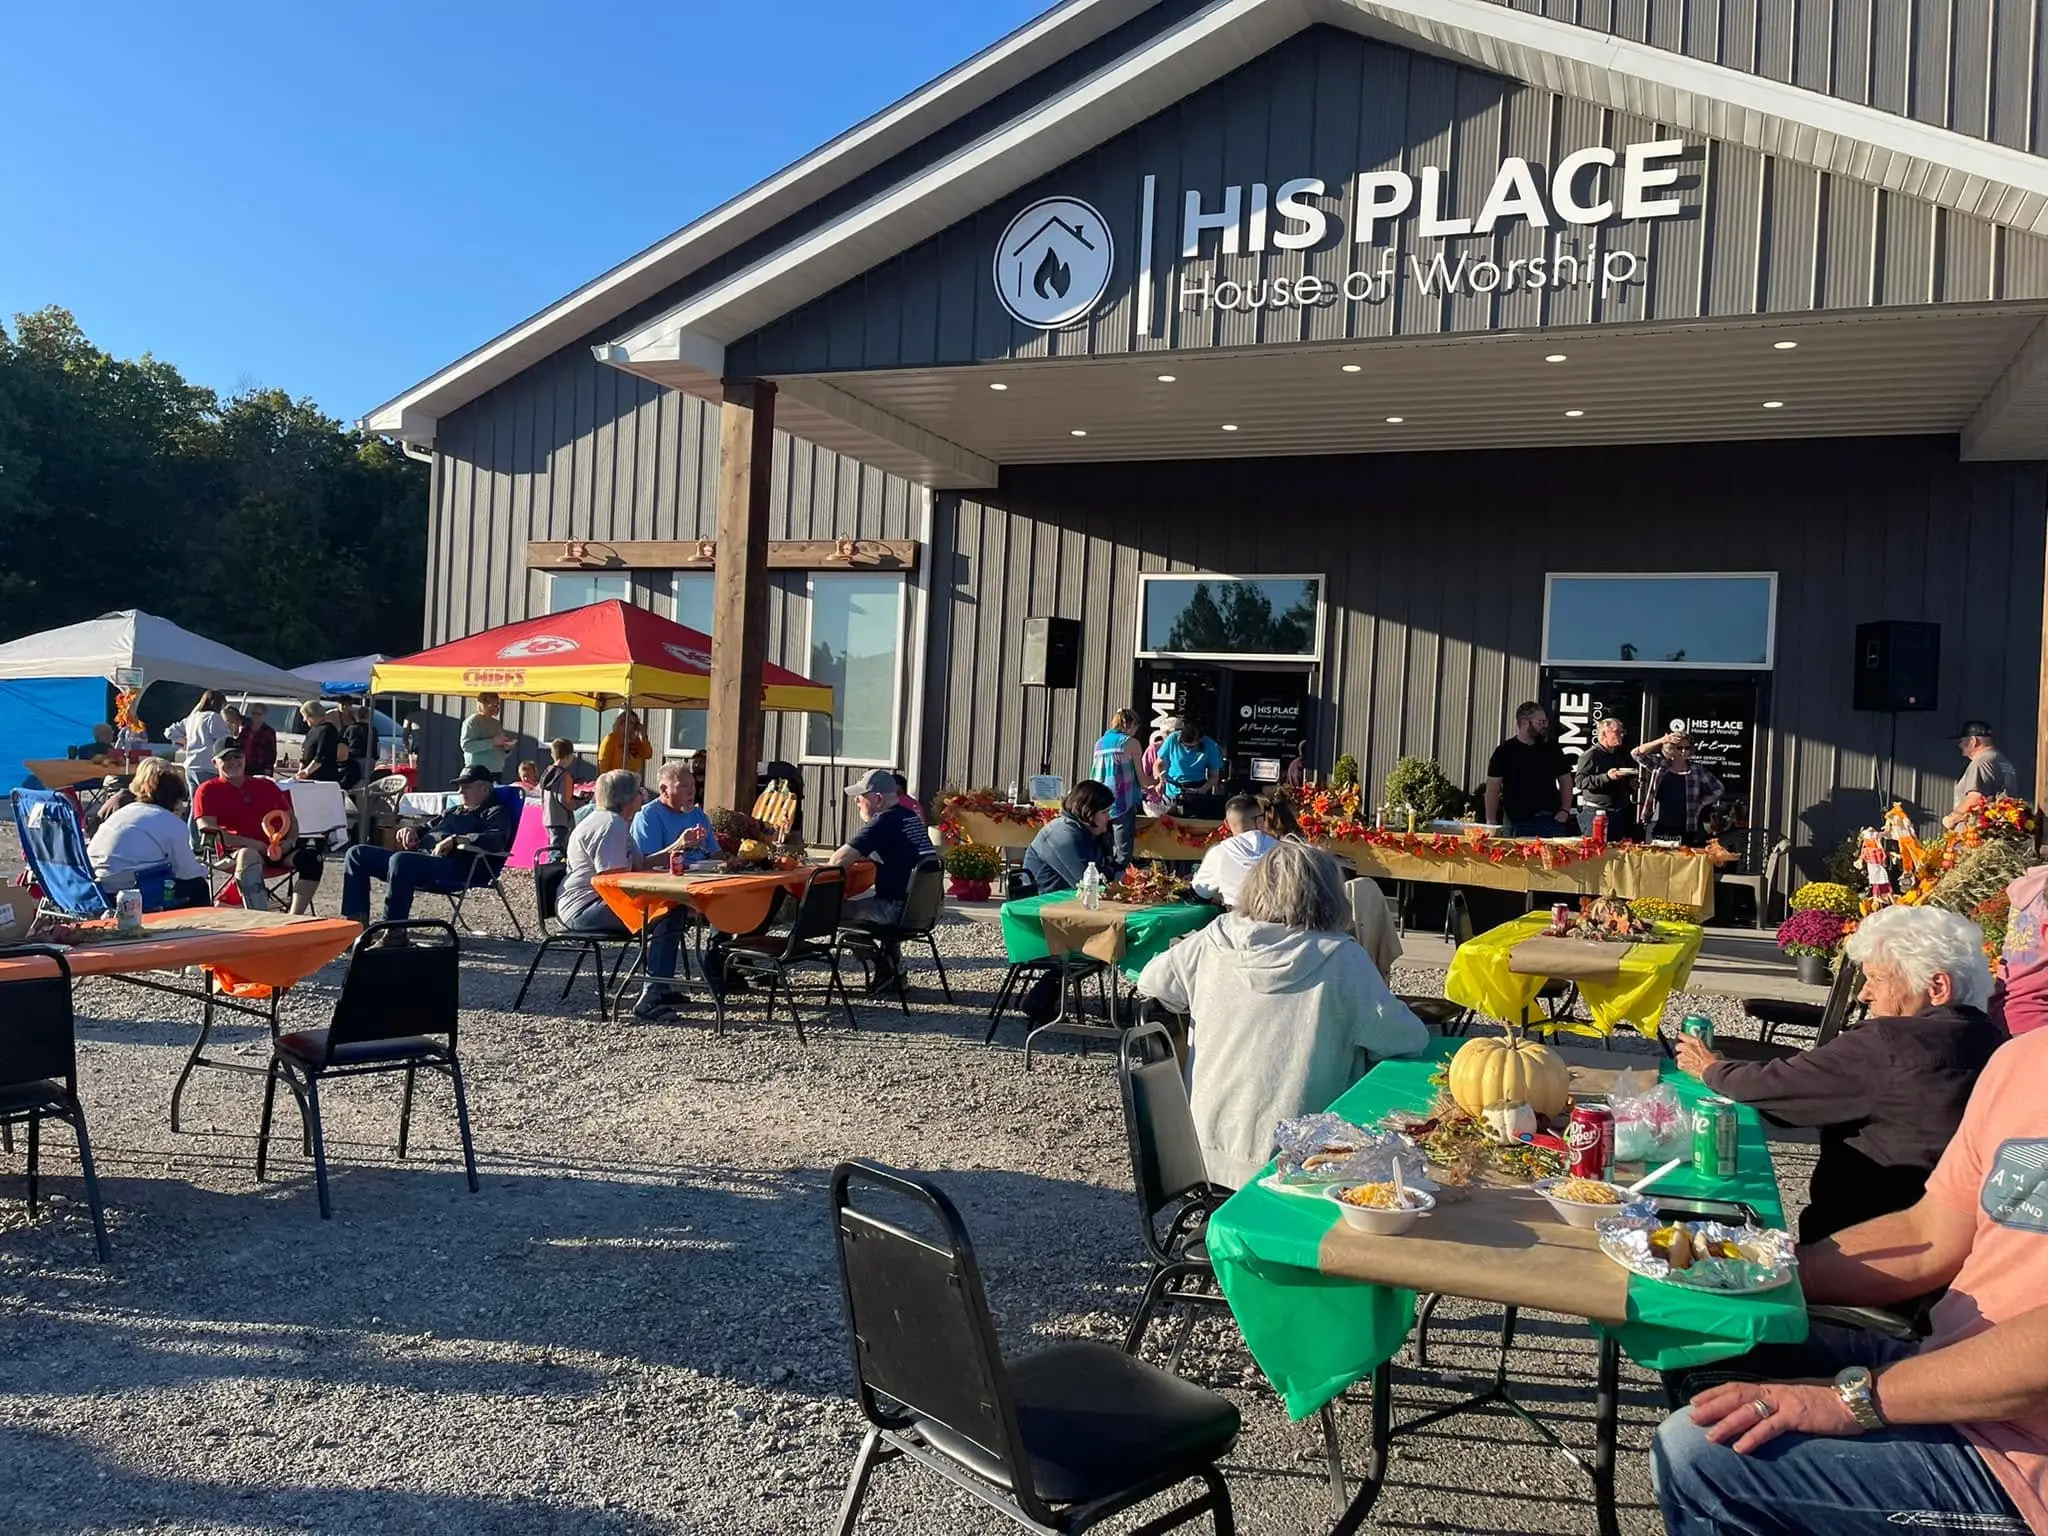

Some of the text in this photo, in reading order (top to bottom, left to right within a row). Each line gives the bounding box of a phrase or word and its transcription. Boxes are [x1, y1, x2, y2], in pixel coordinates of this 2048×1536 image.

[1183, 139, 1683, 257] HIS PLACE
[1179, 232, 1637, 313] House of Worship
[463, 668, 526, 689] CHIEFS
[1257, 706, 1300, 715] HIS PLACE
[1691, 719, 1744, 730] HIS PLACE
[1570, 1121, 1586, 1134] Dr
